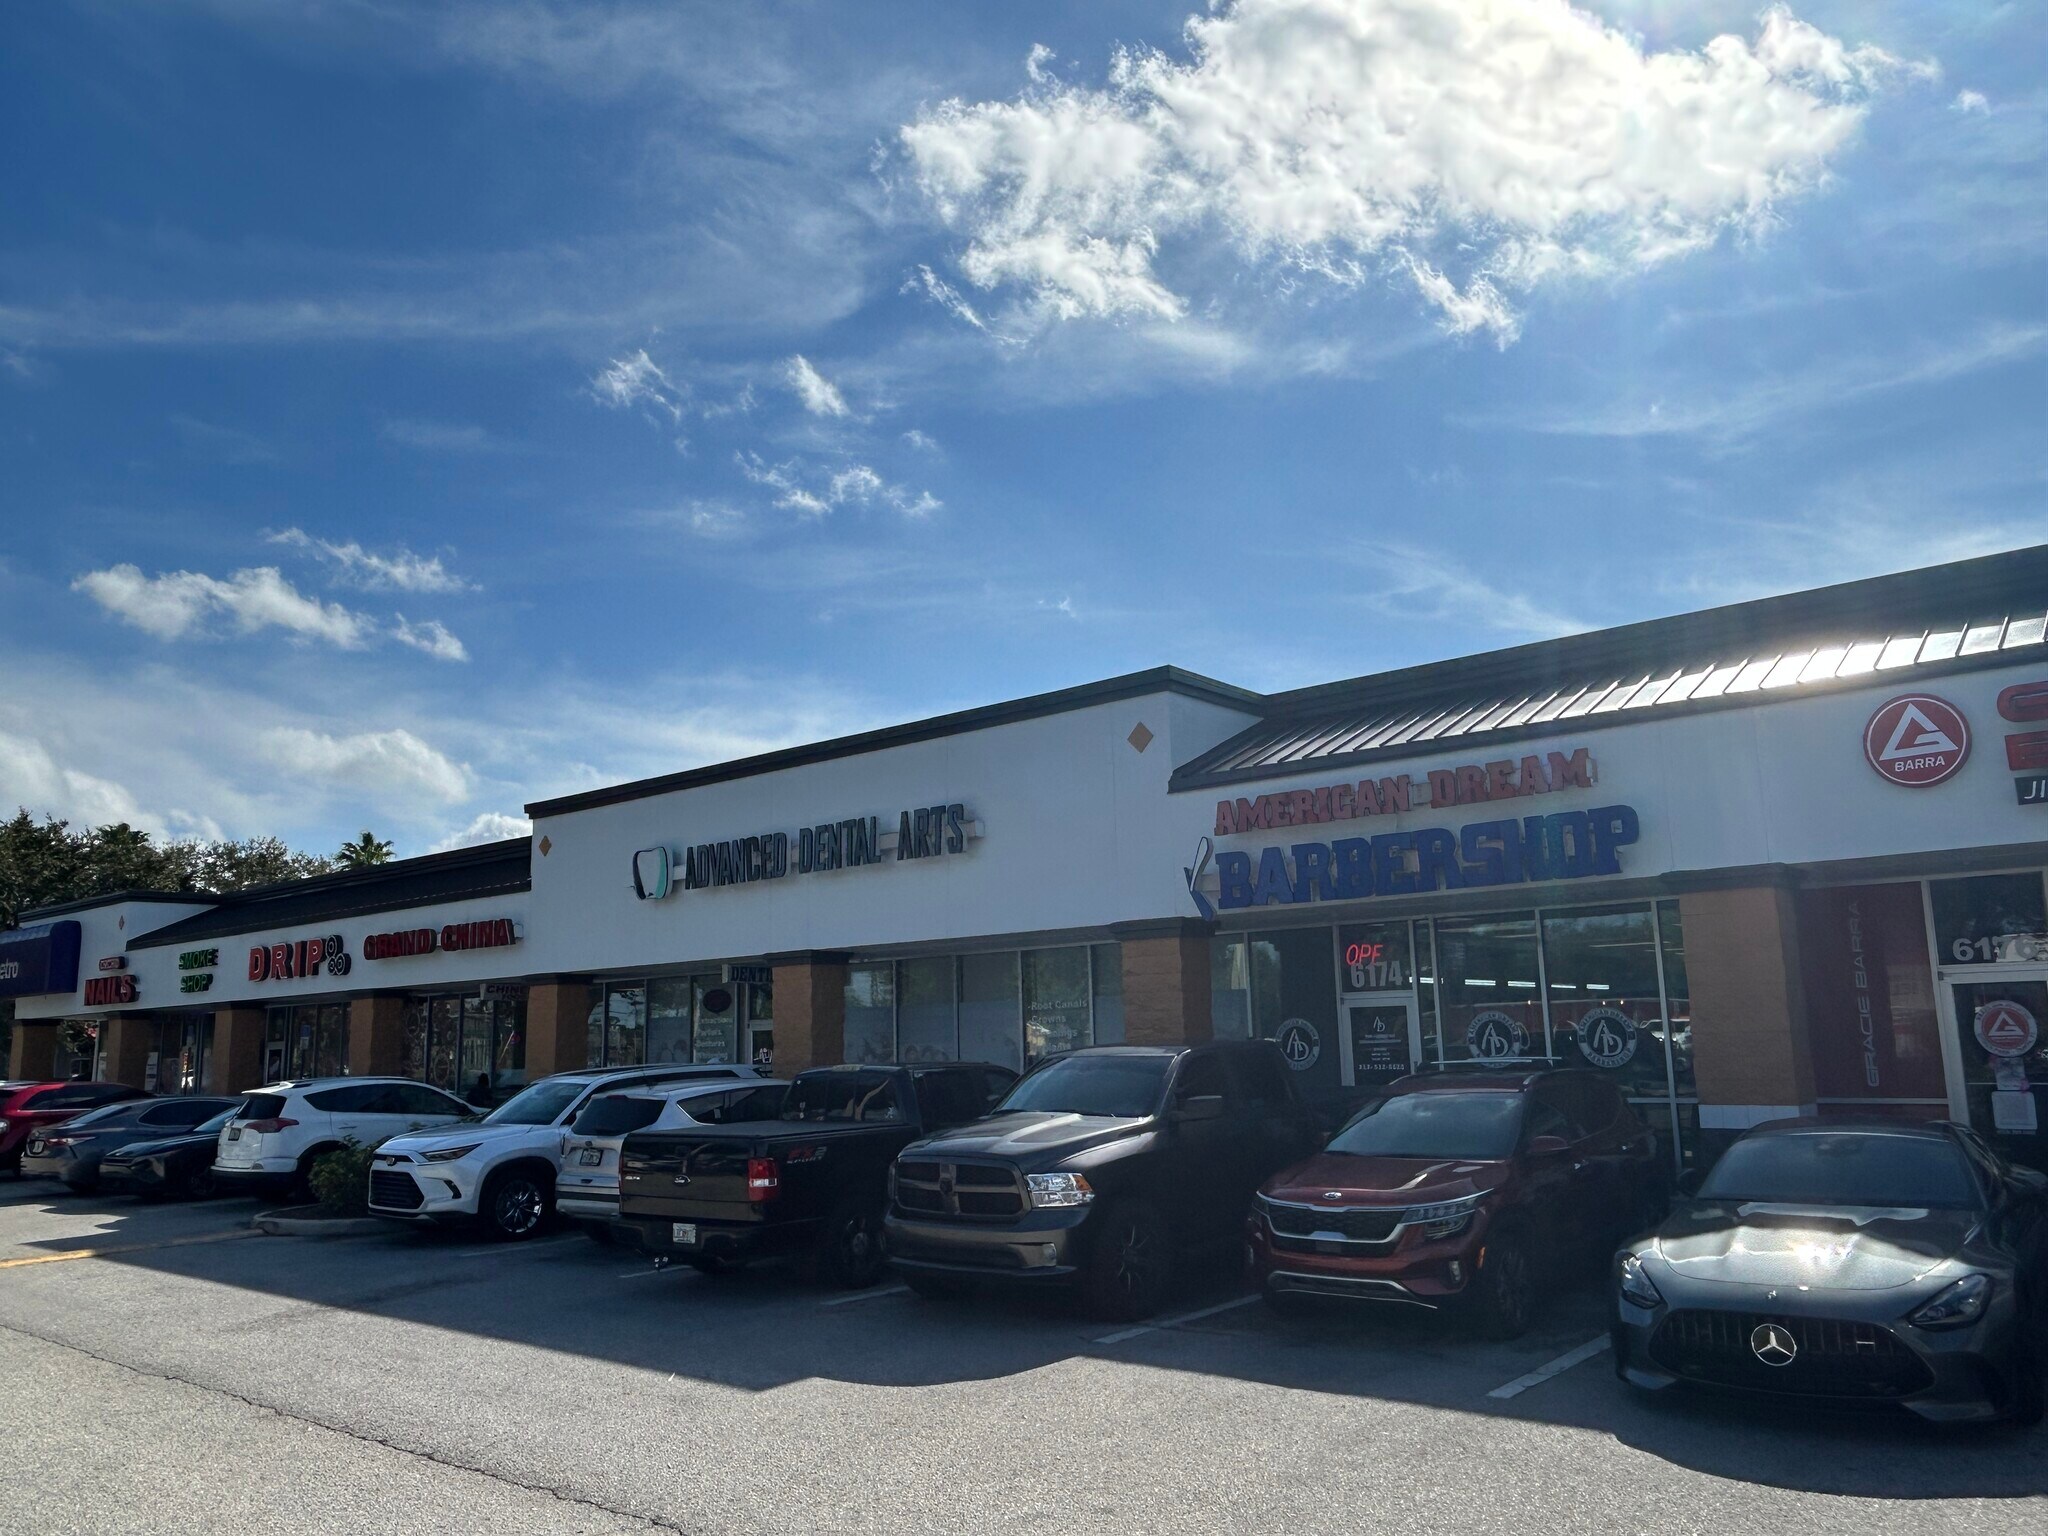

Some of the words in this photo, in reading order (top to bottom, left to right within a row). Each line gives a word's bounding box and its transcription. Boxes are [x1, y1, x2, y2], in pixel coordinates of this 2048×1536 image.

[1894, 755, 1945, 772] BARRA
[1214, 775, 1411, 836] AMERICAN
[1428, 747, 1593, 809] DREAM
[685, 832, 788, 890] ADVANCED
[799, 816, 881, 874] DENTAL
[897, 803, 964, 861] ARTS
[1215, 804, 1640, 909] BARBERSHOP
[364, 928, 436, 960] GRAND
[441, 918, 515, 952] CHINA
[179, 949, 216, 970] SMOKE
[249, 938, 325, 982] DRIP
[1350, 960, 1403, 988] 6174
[84, 975, 136, 1006] NAILS
[180, 974, 212, 993] SHOP
[1031, 1001, 1053, 1011] Root
[1055, 999, 1087, 1009] Canals
